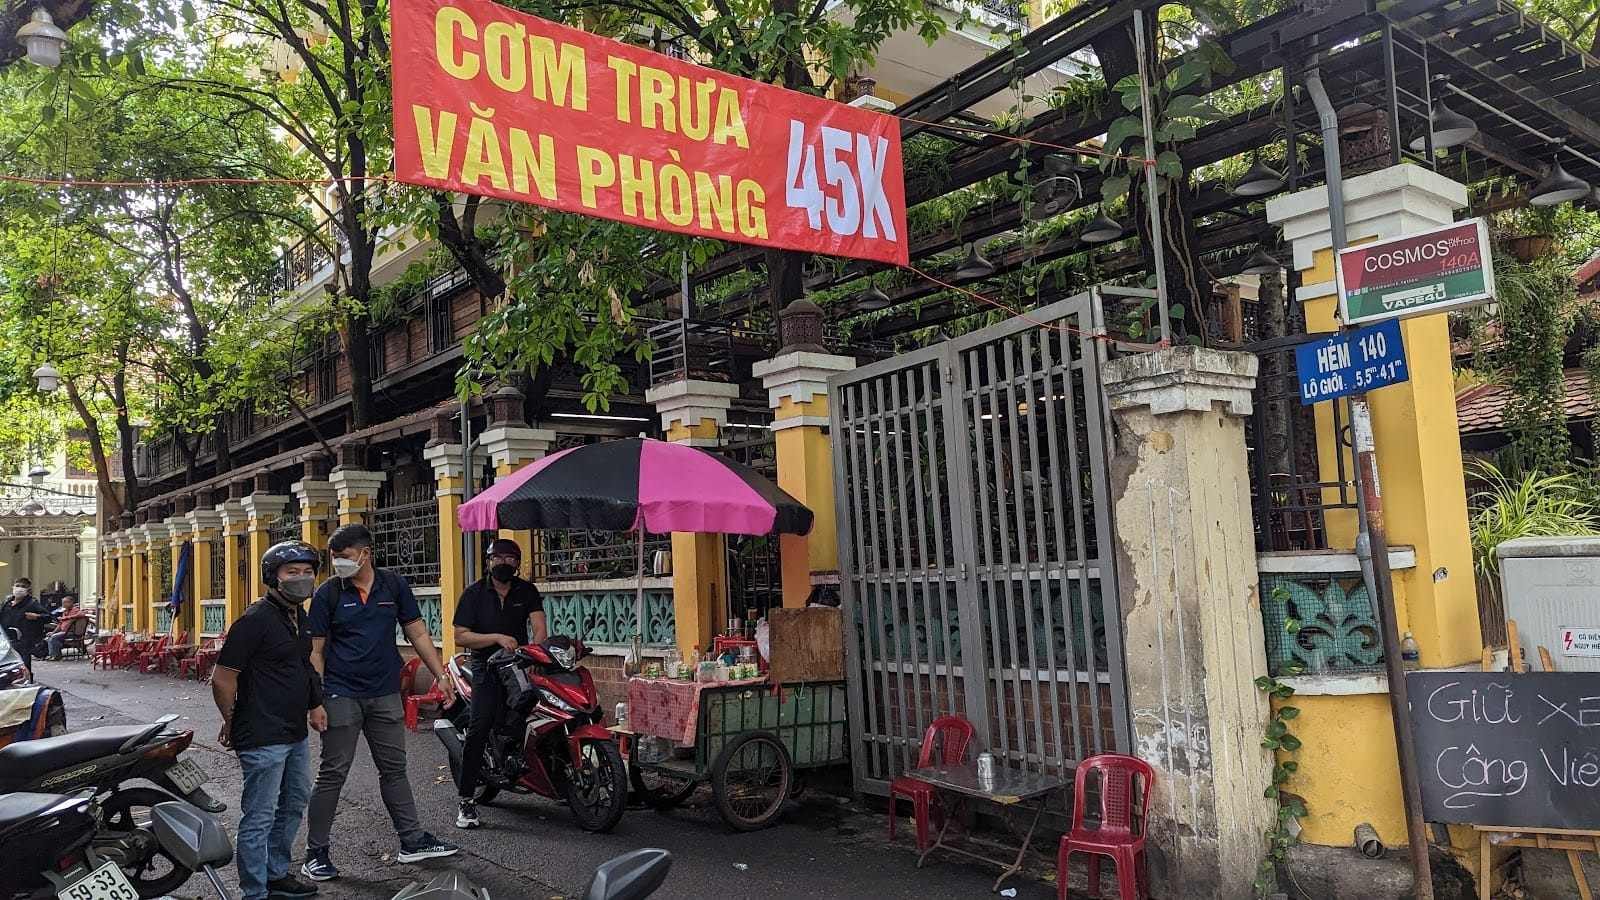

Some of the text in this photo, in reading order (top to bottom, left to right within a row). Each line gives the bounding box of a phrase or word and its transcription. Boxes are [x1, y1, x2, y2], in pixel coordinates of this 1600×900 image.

[435, 6, 750, 149] CƠM TRƯA
[412, 102, 897, 242] VĂN PHÒNG 45K
[1364, 240, 1450, 272] COSMOS
[1440, 251, 1479, 271] 140A
[1383, 290, 1447, 310] VAPE4U
[1317, 331, 1387, 374] HẺM 140
[1436, 743, 1528, 809] Công
